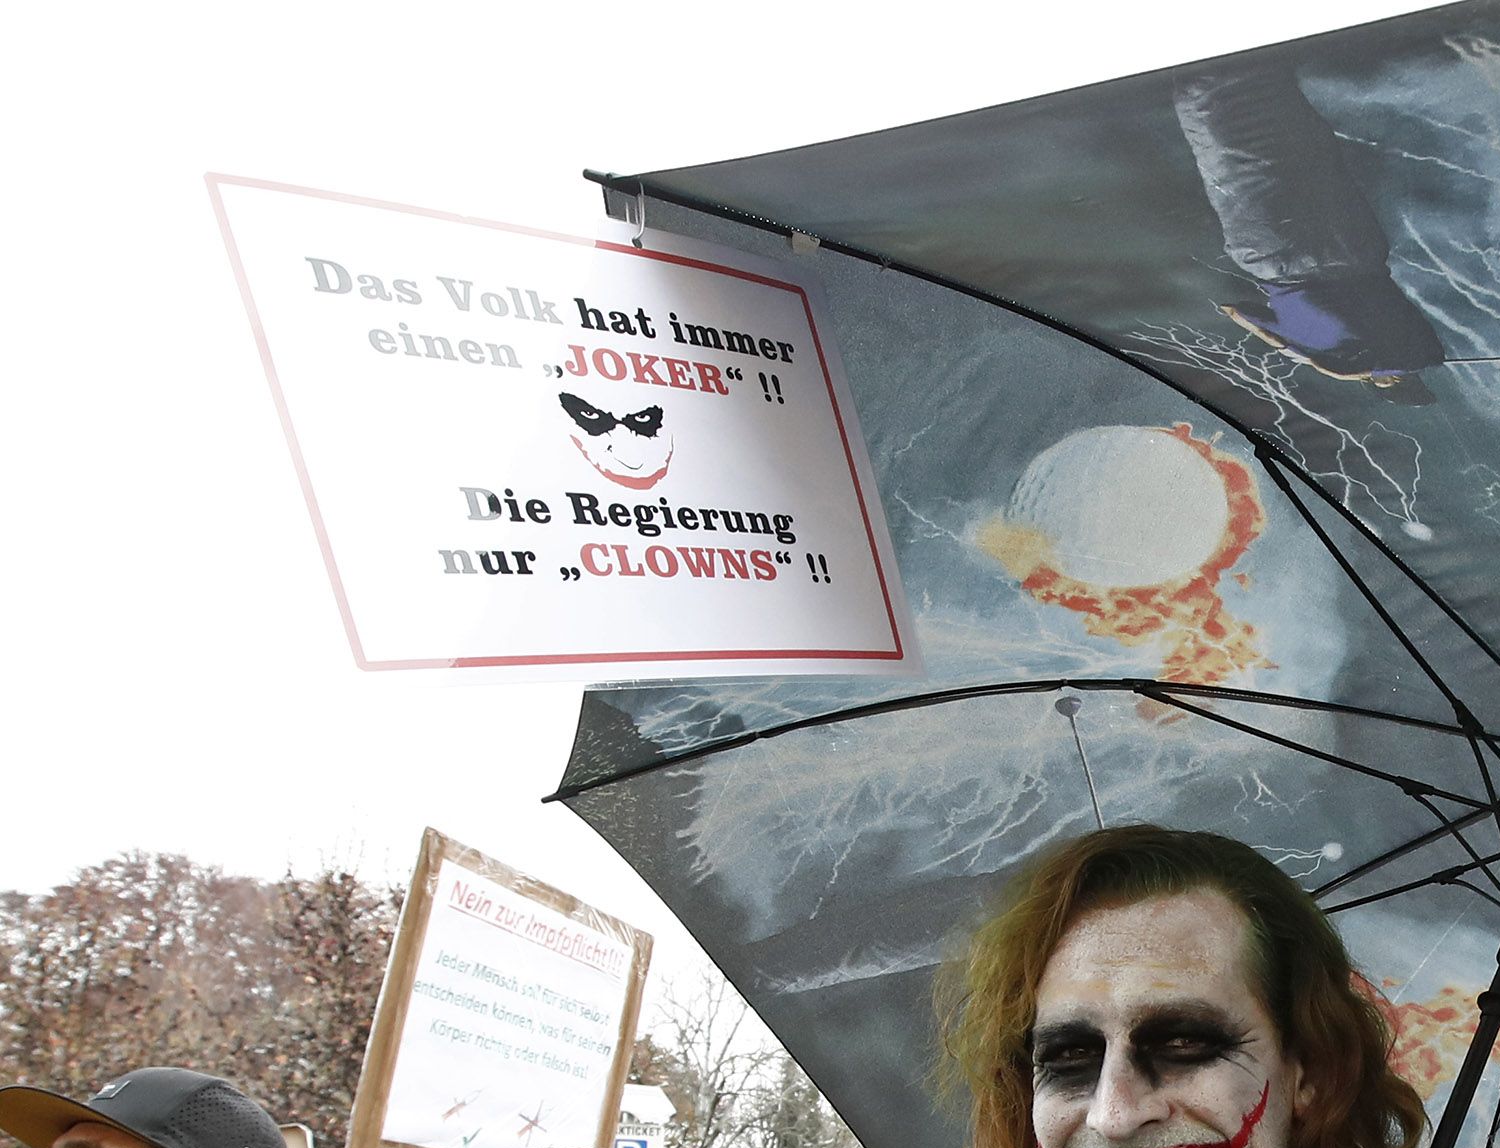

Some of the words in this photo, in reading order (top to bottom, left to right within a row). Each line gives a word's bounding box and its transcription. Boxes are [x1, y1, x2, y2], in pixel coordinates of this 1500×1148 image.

[304, 255, 423, 305] Das
[436, 275, 563, 324] Volk
[574, 298, 657, 339] hat
[669, 312, 795, 365] immer
[367, 322, 523, 370] einen
[459, 486, 552, 525] Die
[565, 491, 797, 544] Regierung
[438, 546, 537, 577] nur
[450, 879, 493, 917] Nein
[495, 904, 526, 930] zur
[616, 1125, 661, 1137] KTICKET
